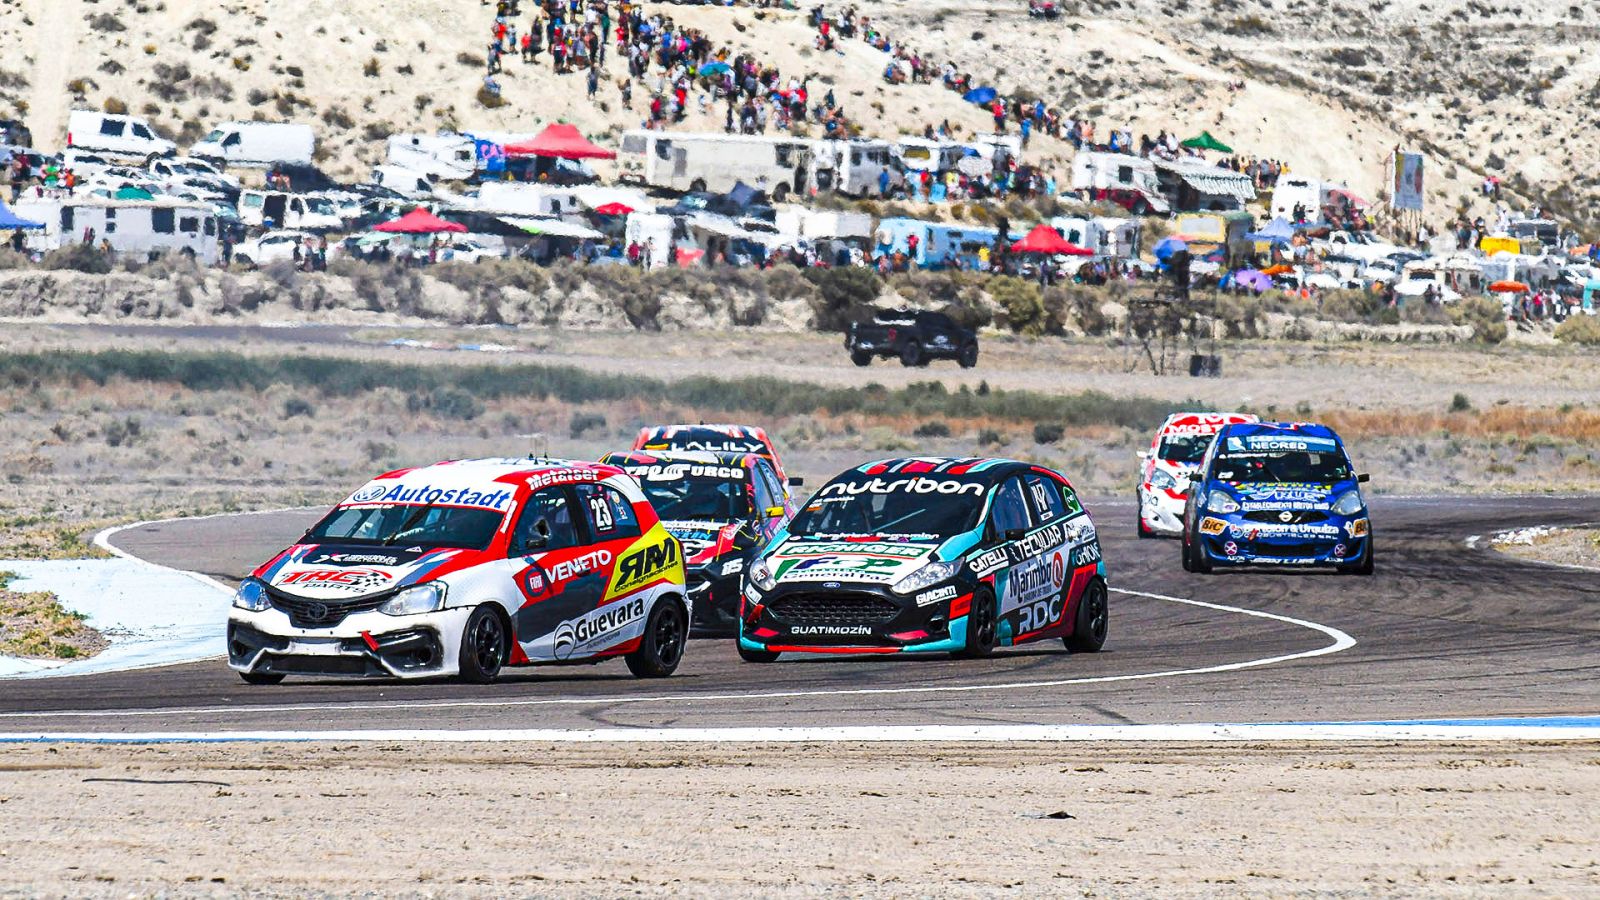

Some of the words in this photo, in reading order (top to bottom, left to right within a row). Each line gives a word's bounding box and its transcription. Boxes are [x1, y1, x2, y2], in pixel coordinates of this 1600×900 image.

[1251, 441, 1307, 450] NEORED
[525, 468, 599, 490] Metalser
[820, 477, 985, 496] nutribon
[380, 484, 511, 509] Autostadt
[590, 498, 612, 527] 23
[545, 550, 612, 584] VENETO
[969, 548, 1008, 572] CATELLI
[783, 572, 855, 580] General
[303, 583, 367, 593] PARTS
[575, 597, 644, 642] Guevara
[1018, 594, 1061, 634] RDC
[791, 625, 872, 635] GUATIMOZÍN
